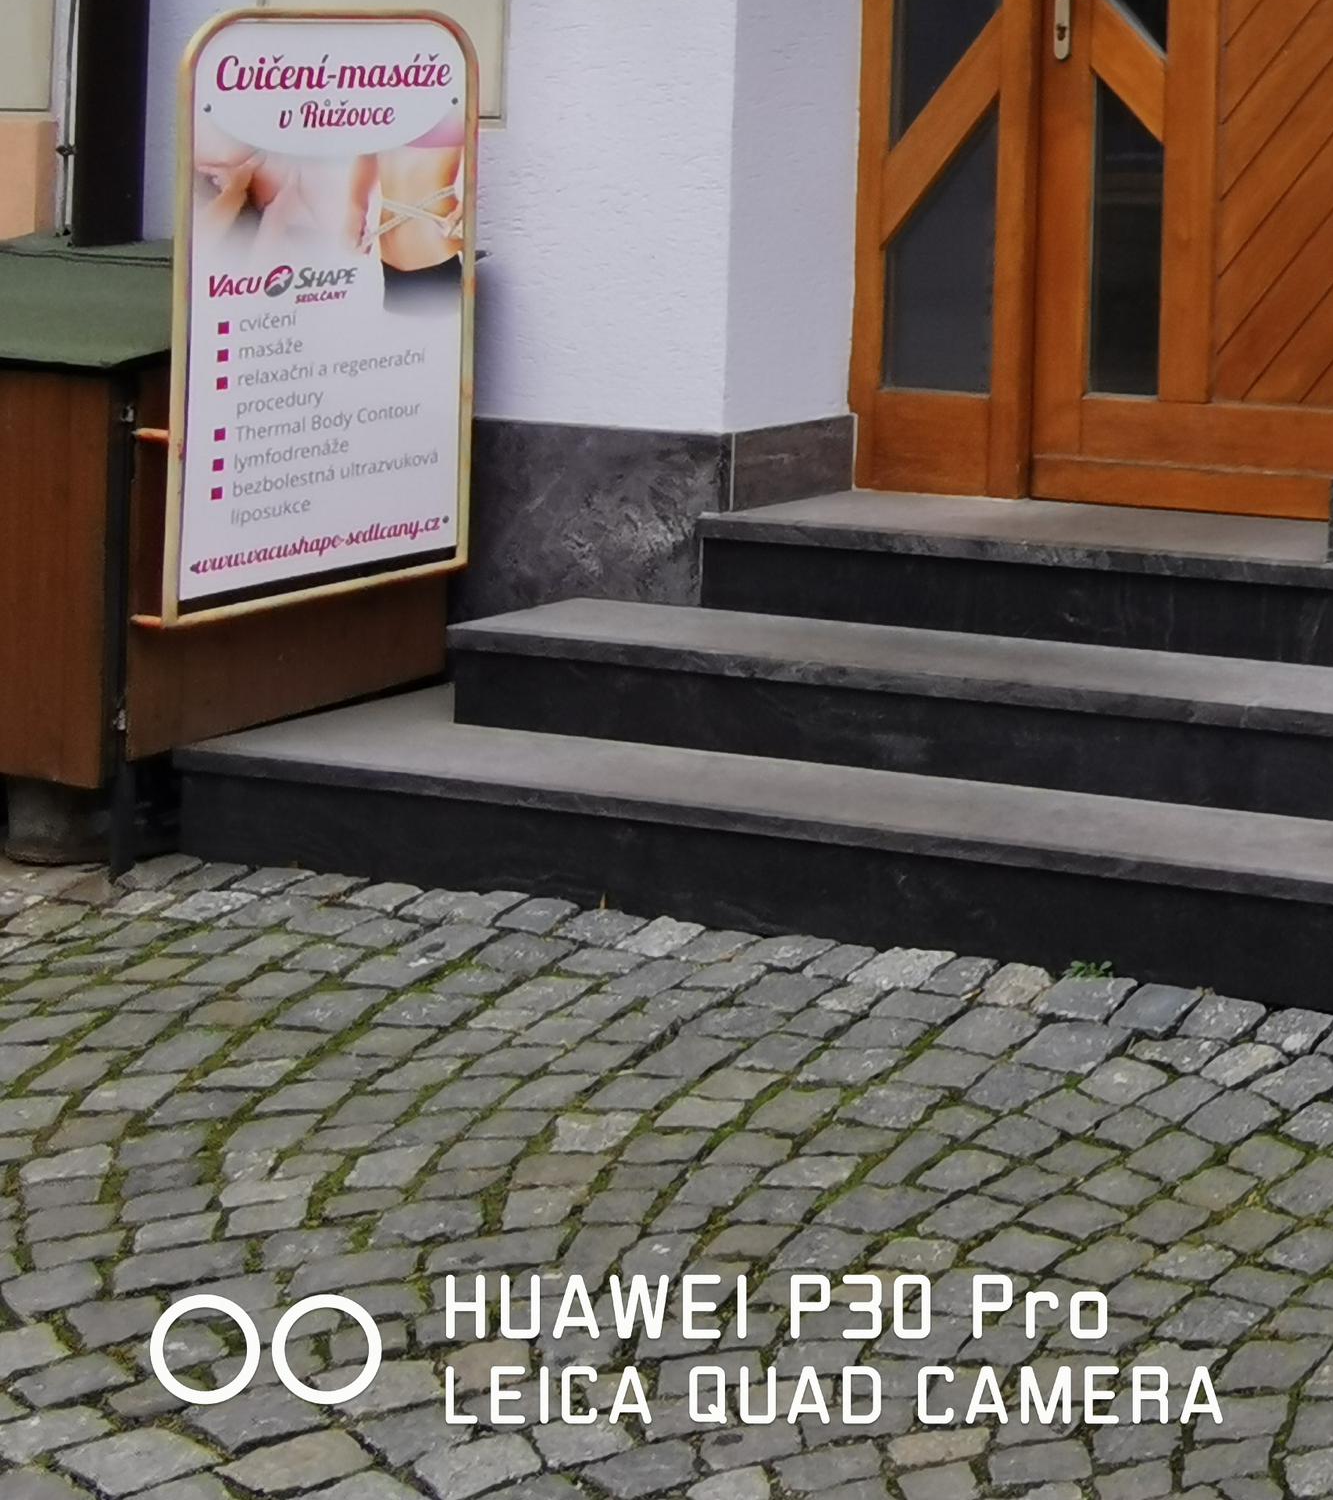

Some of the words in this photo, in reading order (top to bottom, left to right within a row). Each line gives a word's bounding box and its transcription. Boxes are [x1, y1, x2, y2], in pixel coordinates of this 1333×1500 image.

[216, 53, 452, 91] Cvičení-masáže
[278, 110, 292, 128] v
[300, 98, 396, 128] Růžovce
[209, 274, 262, 298] VACU
[294, 266, 358, 290] SHAPE
[295, 290, 348, 304] SEDLČANY
[239, 311, 297, 333] cvičení
[238, 338, 303, 360] masáže
[237, 365, 314, 387] relaxační
[318, 365, 327, 376] a
[333, 349, 425, 377] regenerační
[236, 391, 323, 418] procedury
[236, 422, 307, 442] Thermal
[312, 413, 352, 432] Body
[357, 402, 421, 424] Contour
[233, 438, 349, 473] lymfodrenáže
[232, 467, 335, 497] bezbolestná
[340, 449, 438, 479] ultrazvuková
[230, 498, 311, 527] liposukce
[193, 516, 440, 574] www.vacushape-sedlcany.cz
